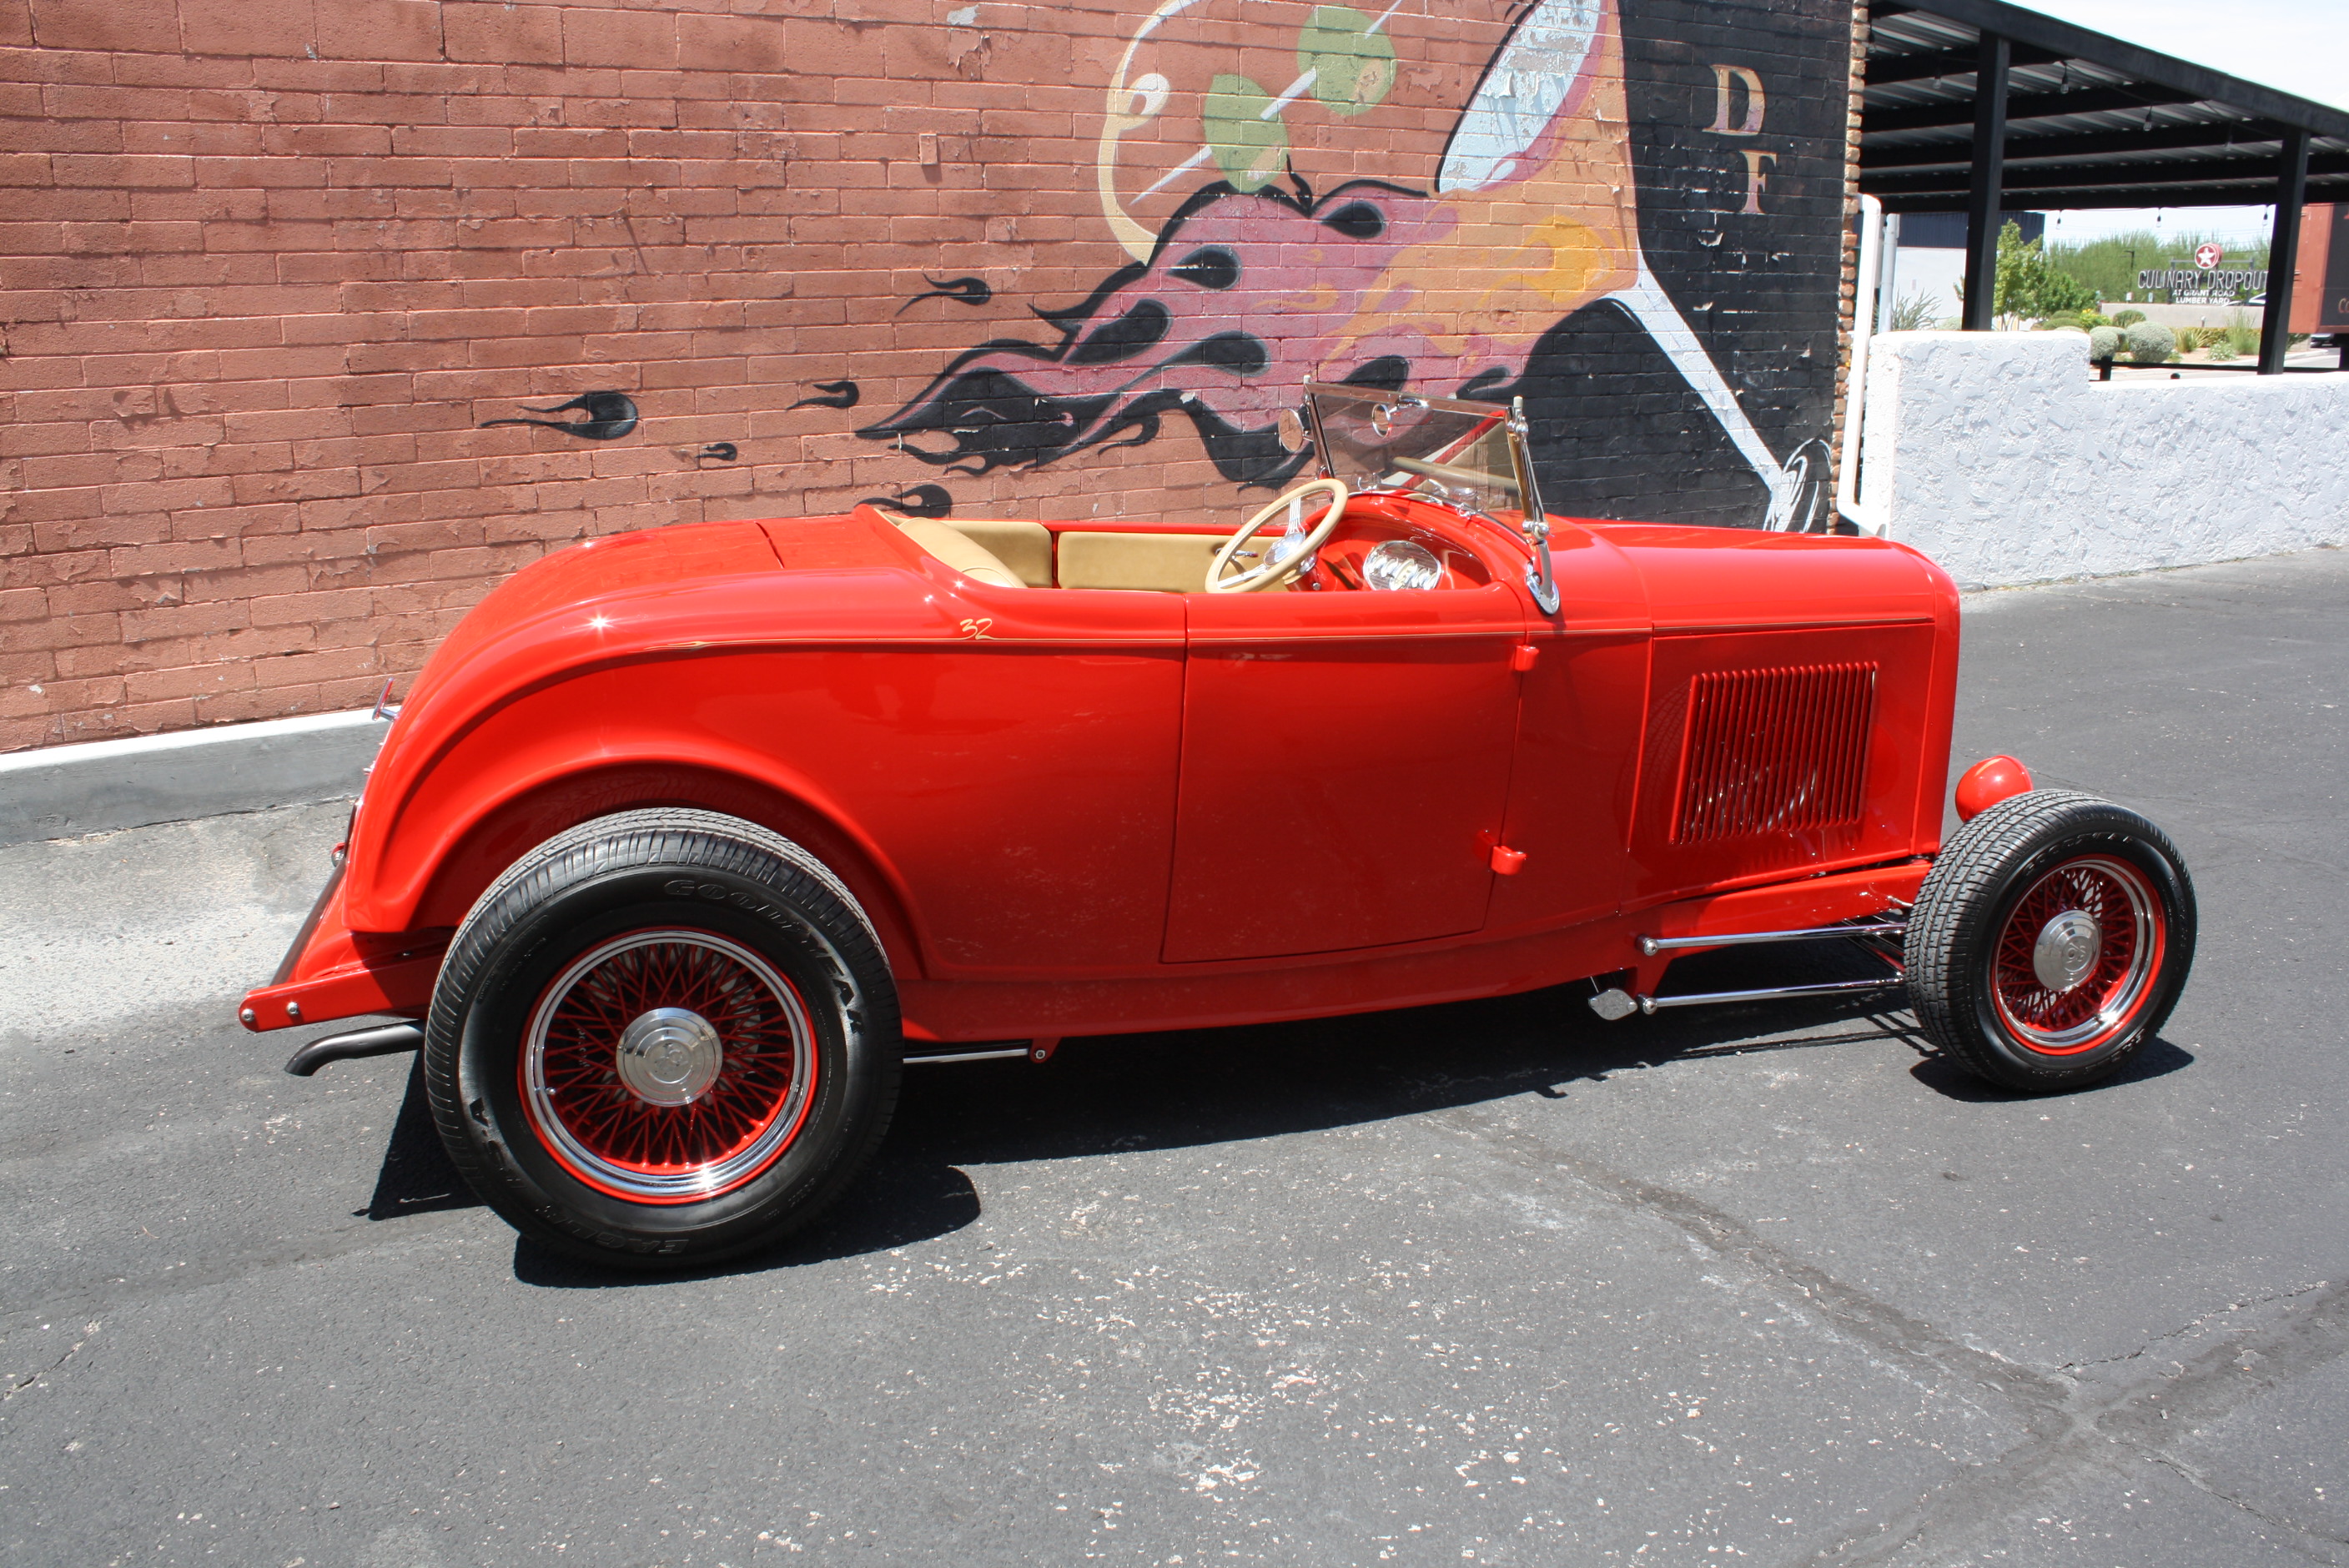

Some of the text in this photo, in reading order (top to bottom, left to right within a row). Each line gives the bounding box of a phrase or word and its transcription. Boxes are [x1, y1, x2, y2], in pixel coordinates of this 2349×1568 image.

[1703, 64, 1766, 137] D
[1738, 149, 1778, 214] F
[2138, 269, 2202, 289] CULINARY
[960, 618, 993, 641] 32
[664, 879, 866, 1036] GOODYEAR
